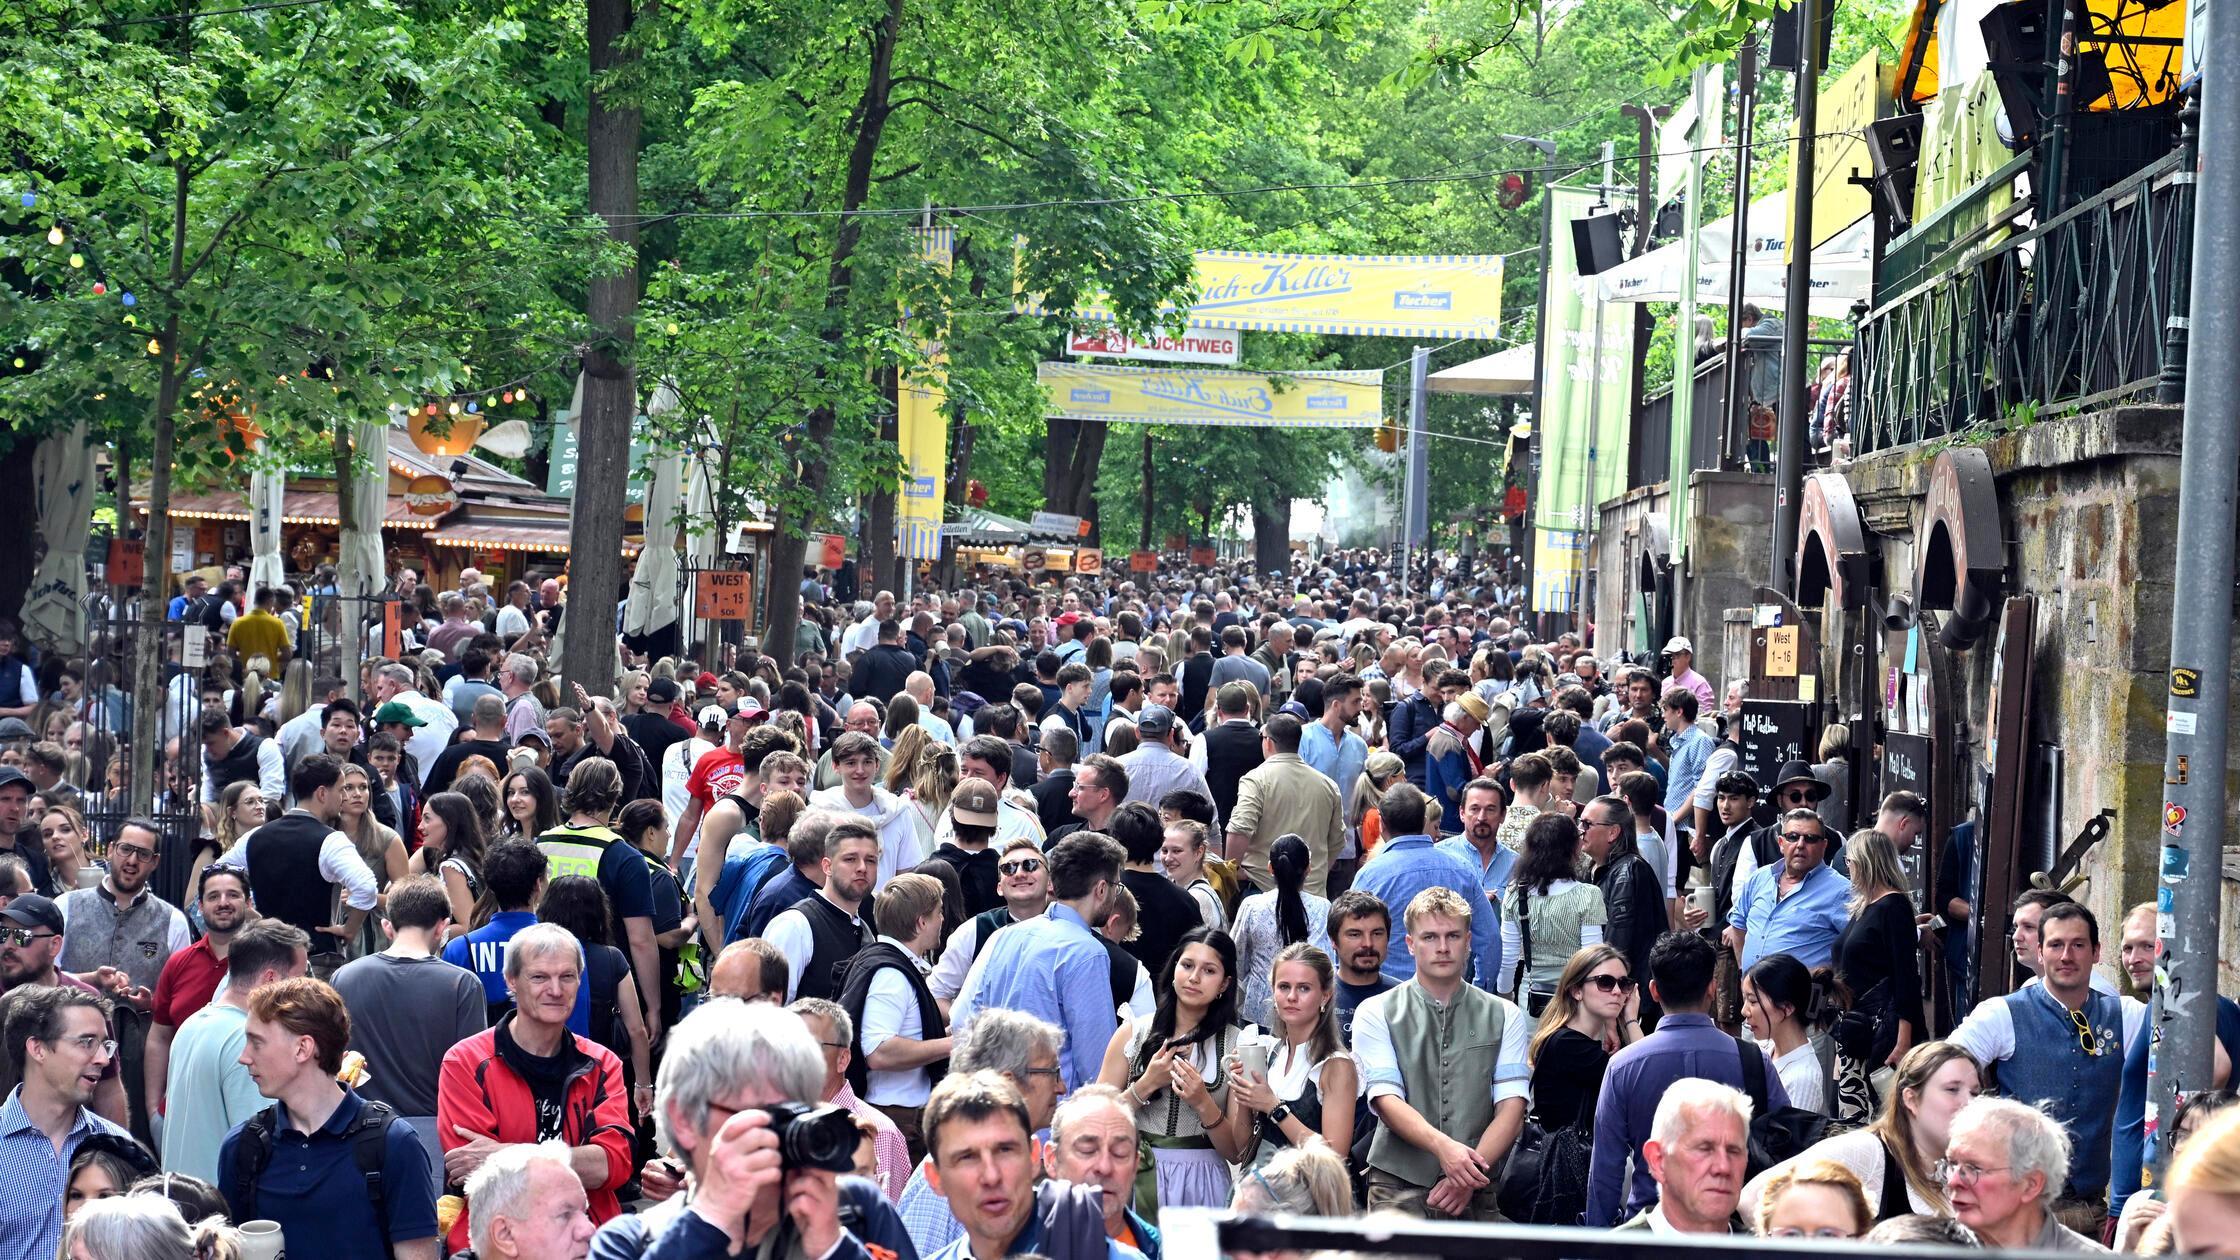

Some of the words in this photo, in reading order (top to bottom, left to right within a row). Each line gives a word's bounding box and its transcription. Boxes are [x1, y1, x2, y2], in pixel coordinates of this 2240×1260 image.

[1399, 294, 1448, 306] Tucher
[711, 575, 745, 586] WEST
[712, 593, 719, 604] 1
[733, 593, 744, 604] 15
[1773, 632, 1791, 644] West
[1772, 650, 1776, 662] 1
[1784, 650, 1791, 662] 16
